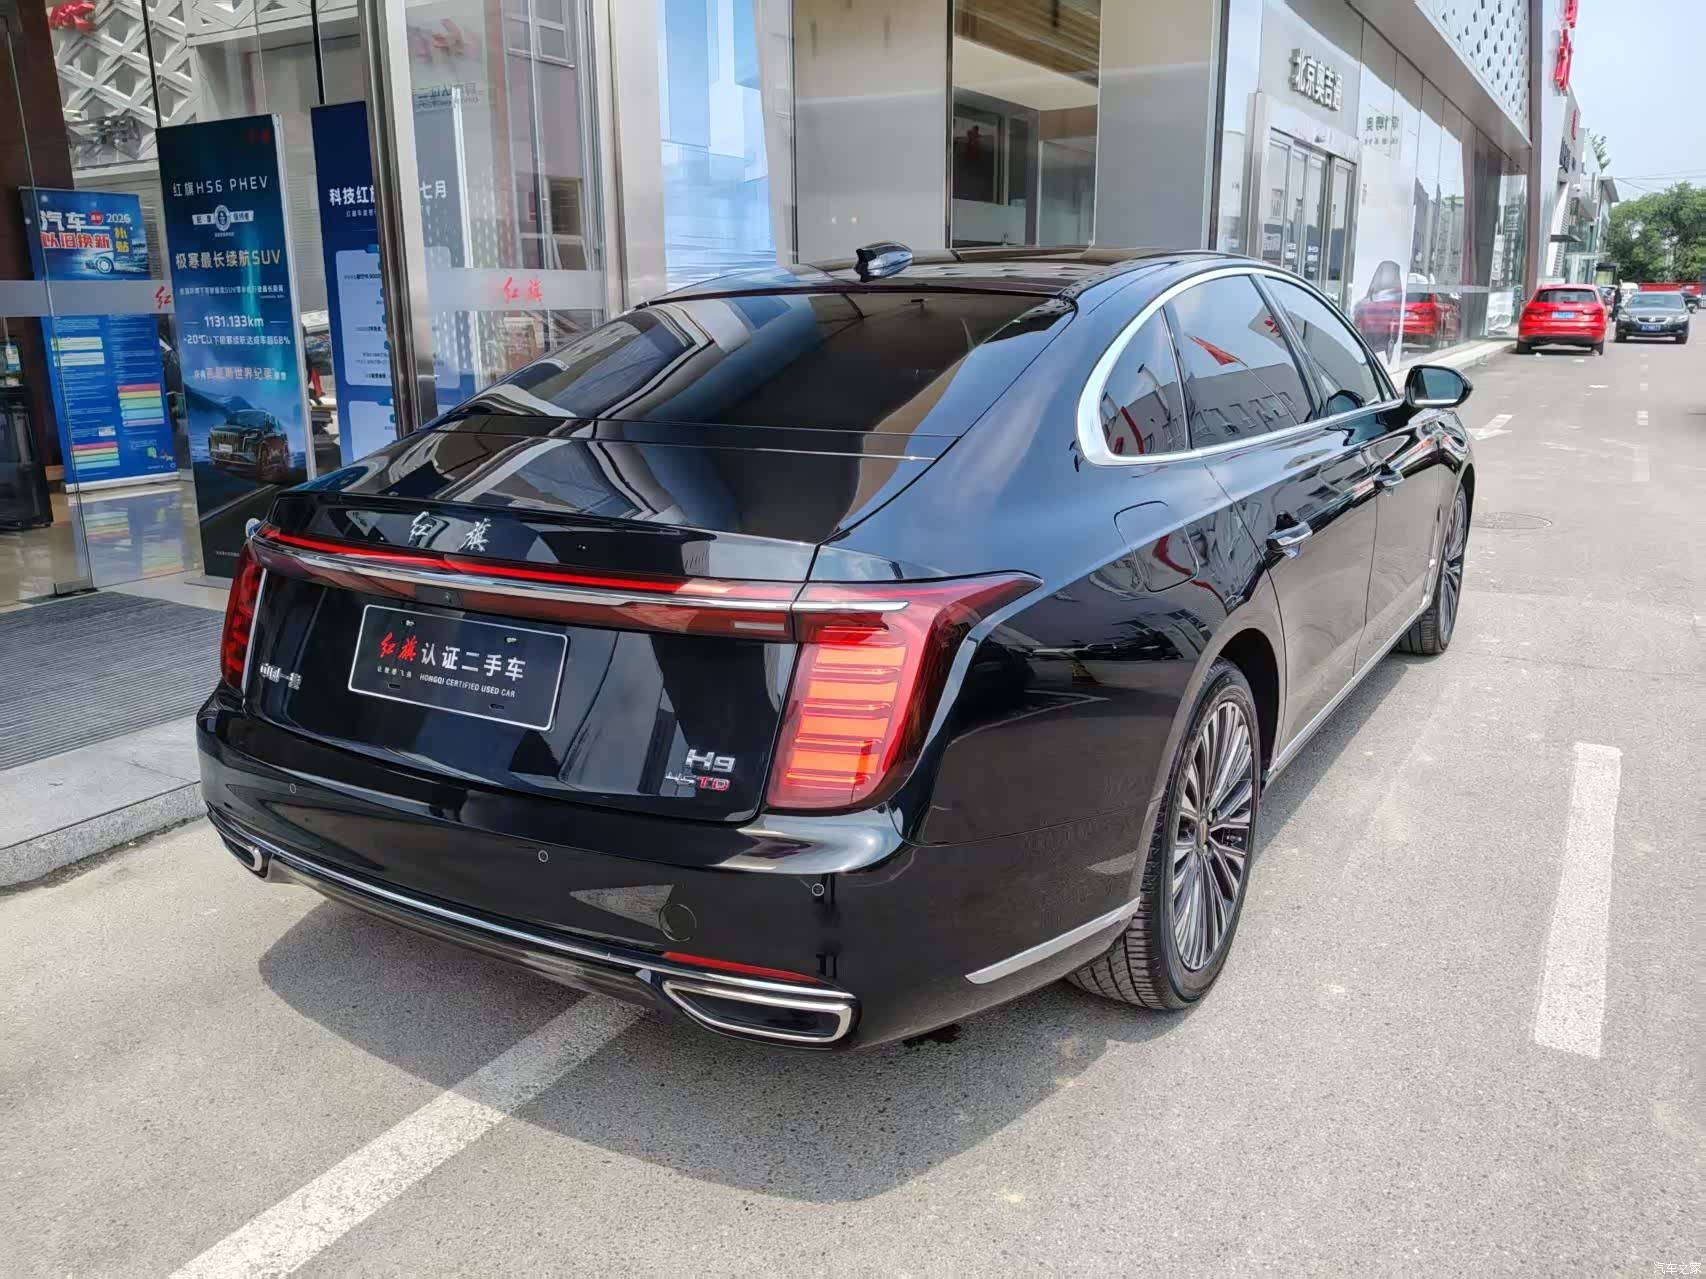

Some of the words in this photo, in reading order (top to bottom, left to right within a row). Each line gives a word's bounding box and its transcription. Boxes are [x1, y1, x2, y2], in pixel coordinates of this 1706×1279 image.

[229, 175, 268, 191] PHEV
[420, 180, 447, 199] 七月
[40, 210, 87, 231] 汽车
[106, 213, 131, 224] 2026
[40, 232, 110, 249] 以旧换新
[175, 249, 281, 269] 极寒最长续航SUV
[503, 275, 544, 304] 红旗
[204, 315, 264, 328] 1131.133km
[407, 511, 492, 552] 红旗
[379, 632, 417, 662] 红旗
[421, 642, 526, 681] 认证二手车
[420, 673, 445, 685] HONGQI
[446, 678, 480, 691] CERTIFIED
[481, 685, 500, 695] USED
[500, 688, 516, 698] CAR
[685, 748, 736, 773] H9
